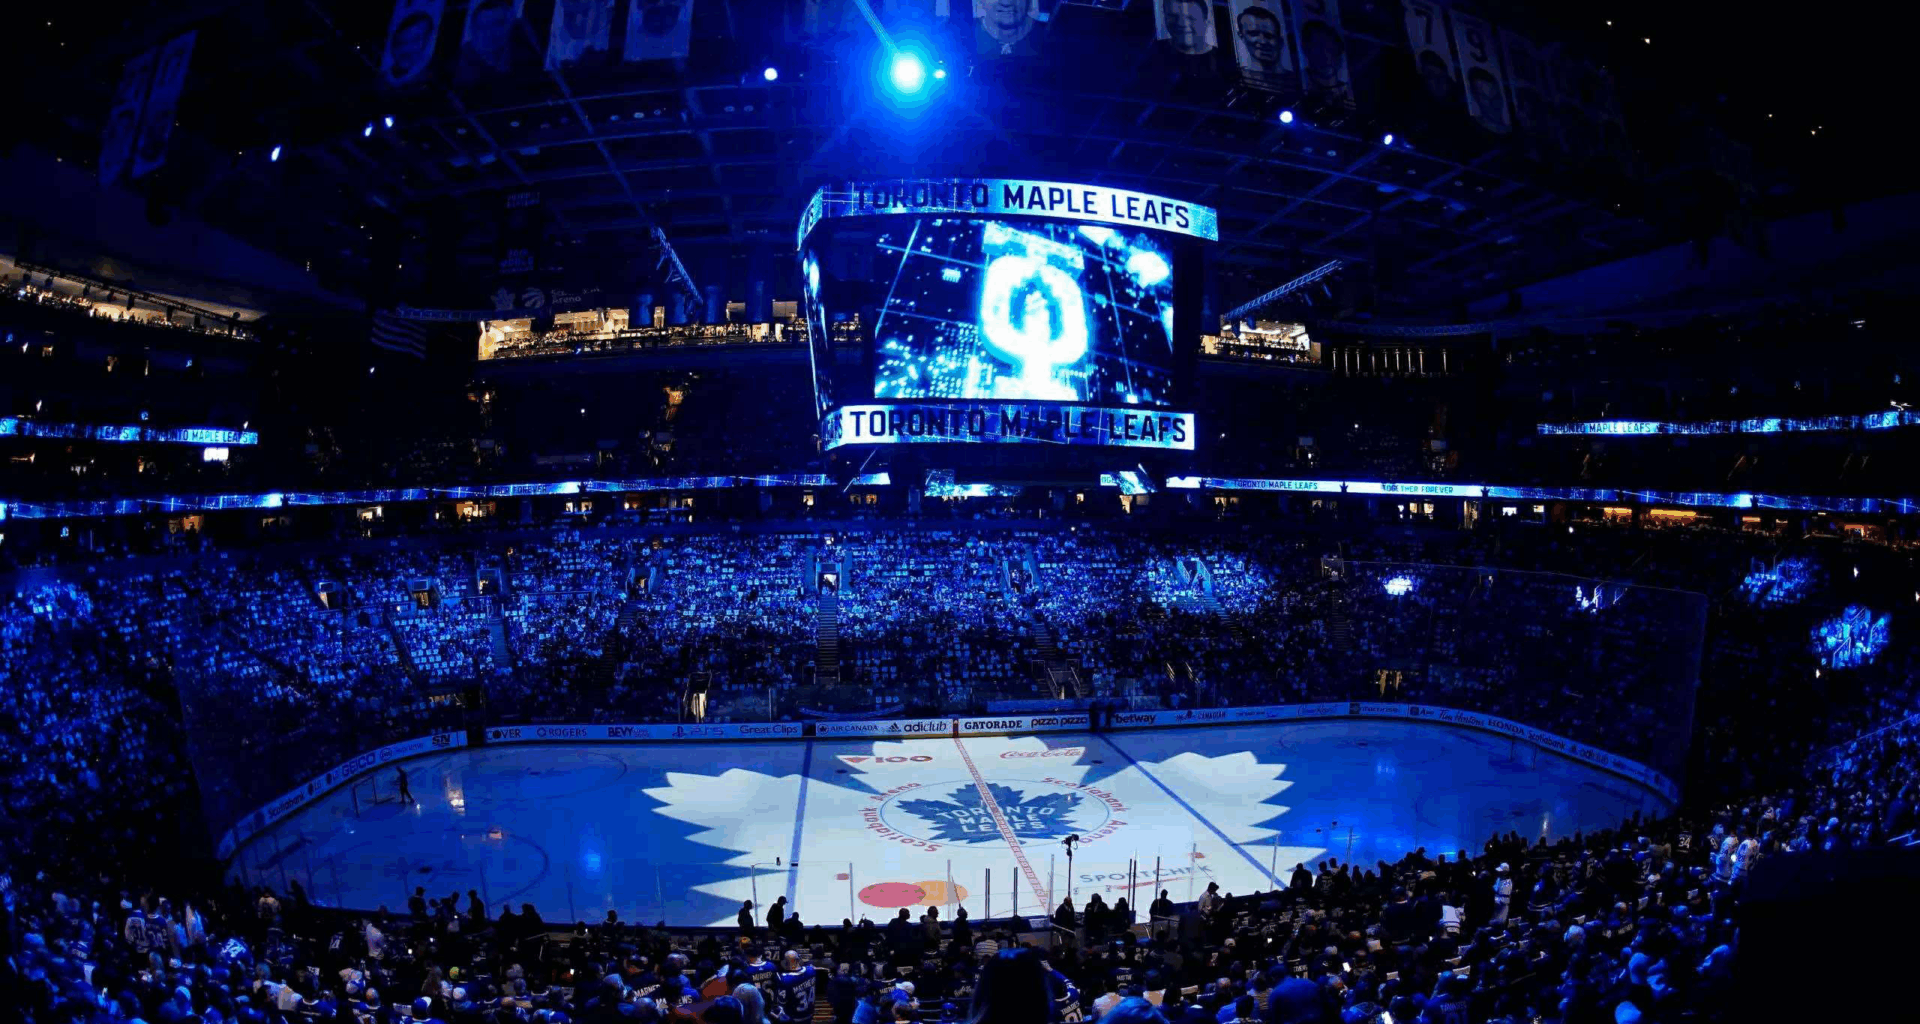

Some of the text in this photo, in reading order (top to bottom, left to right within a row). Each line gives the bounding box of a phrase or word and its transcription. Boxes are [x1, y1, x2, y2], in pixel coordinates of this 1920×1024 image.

[1465, 28, 1488, 62] 9
[856, 183, 1190, 229] TORONTO MAPLE LEAFS
[850, 410, 986, 437] TORONTO
[1000, 411, 1098, 438] MAPLE
[1109, 413, 1186, 442] LEAFS
[1589, 422, 1618, 433] MAPLE
[1622, 422, 1651, 433] LEAFS
[192, 429, 219, 442] MAPLE
[1233, 479, 1318, 490] TORONTO MAPLE LEAFS
[1421, 486, 1454, 494] FOREVER
[964, 719, 1023, 730] GATORADE
[1031, 715, 1088, 728] pizza pizza
[1115, 713, 1157, 724] betway
[548, 727, 588, 737] ROGERS
[607, 726, 634, 738] BEVY
[739, 724, 798, 736] Great Clips
[845, 724, 879, 732] CANADA
[903, 720, 947, 732] adiclub
[1487, 718, 1525, 736] HONDA
[1527, 729, 1566, 750] Scotiabank
[341, 753, 376, 777] GEICO
[875, 755, 933, 764] 100
